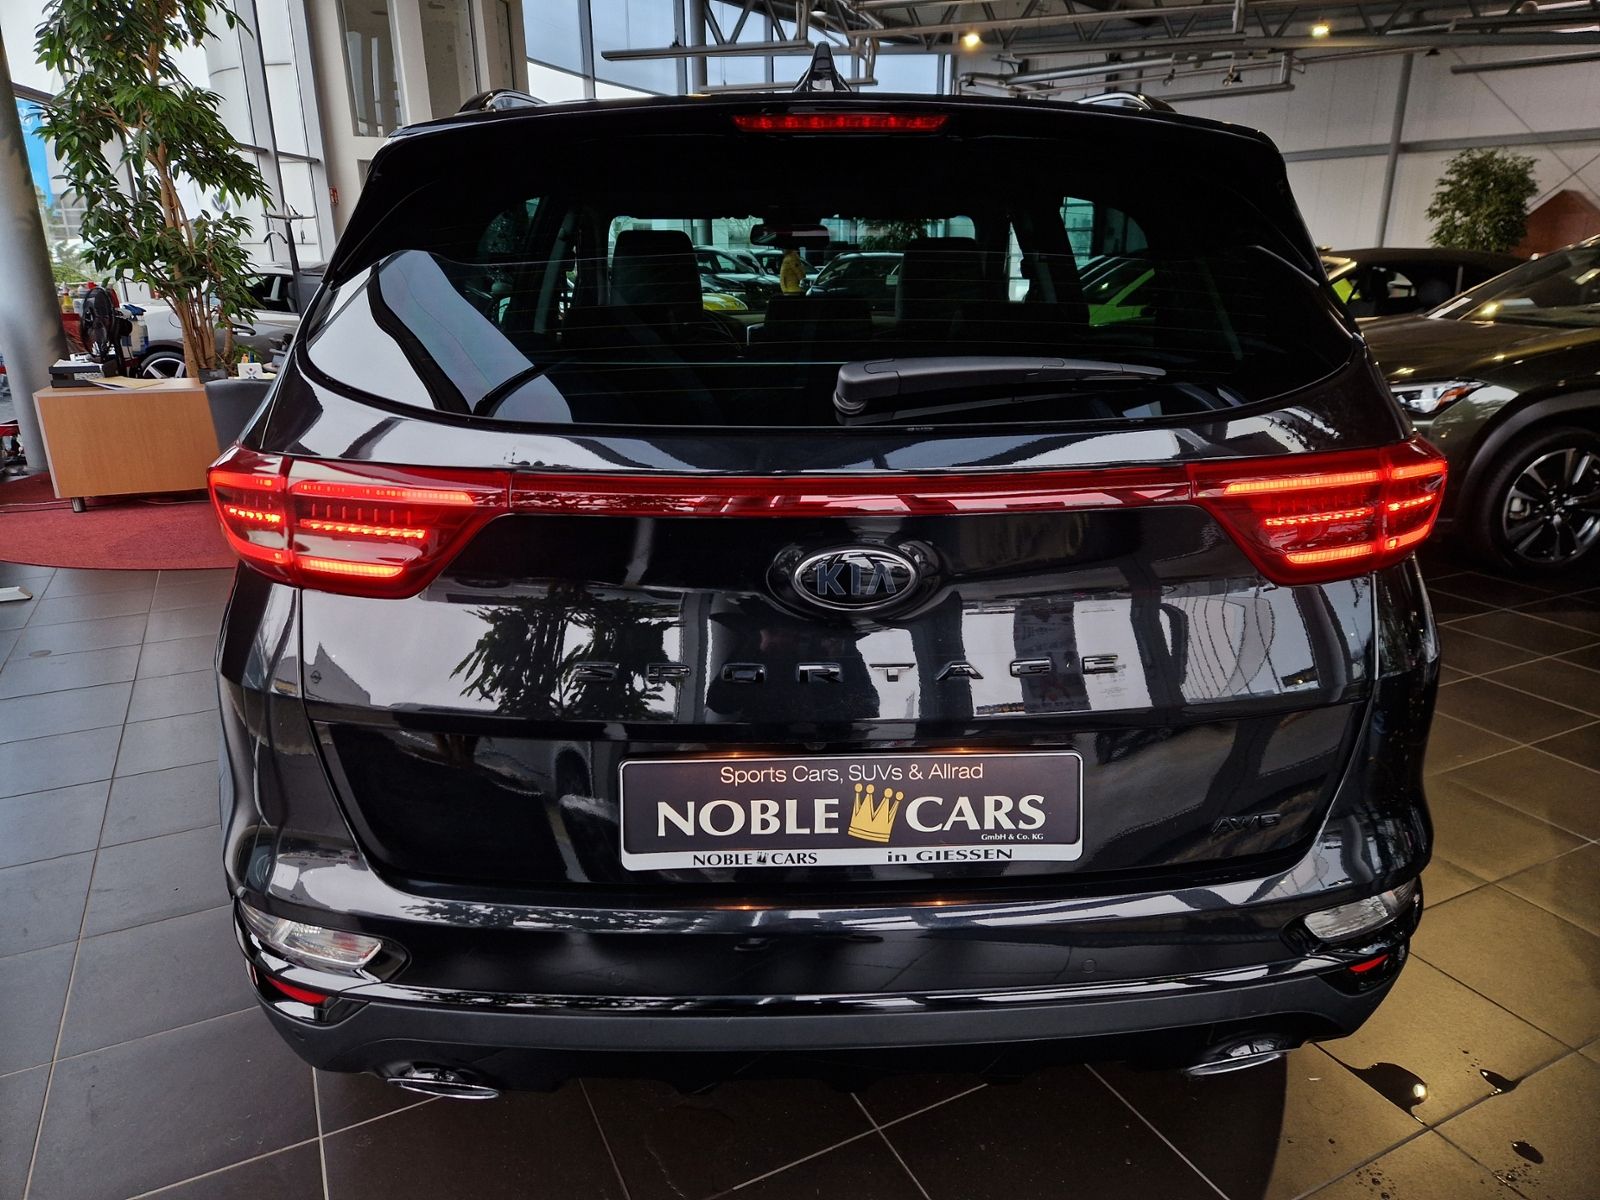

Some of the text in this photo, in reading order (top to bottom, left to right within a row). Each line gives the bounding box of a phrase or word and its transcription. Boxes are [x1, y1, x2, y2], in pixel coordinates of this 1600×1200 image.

[815, 562, 898, 596] KIA
[720, 763, 984, 787] Sports Cars, SUVs & Allrad
[657, 794, 1046, 837] NOBLE CARS
[981, 833, 1007, 841] GmbH
[693, 848, 1013, 866] NOBLE CARS in GIESSEN
